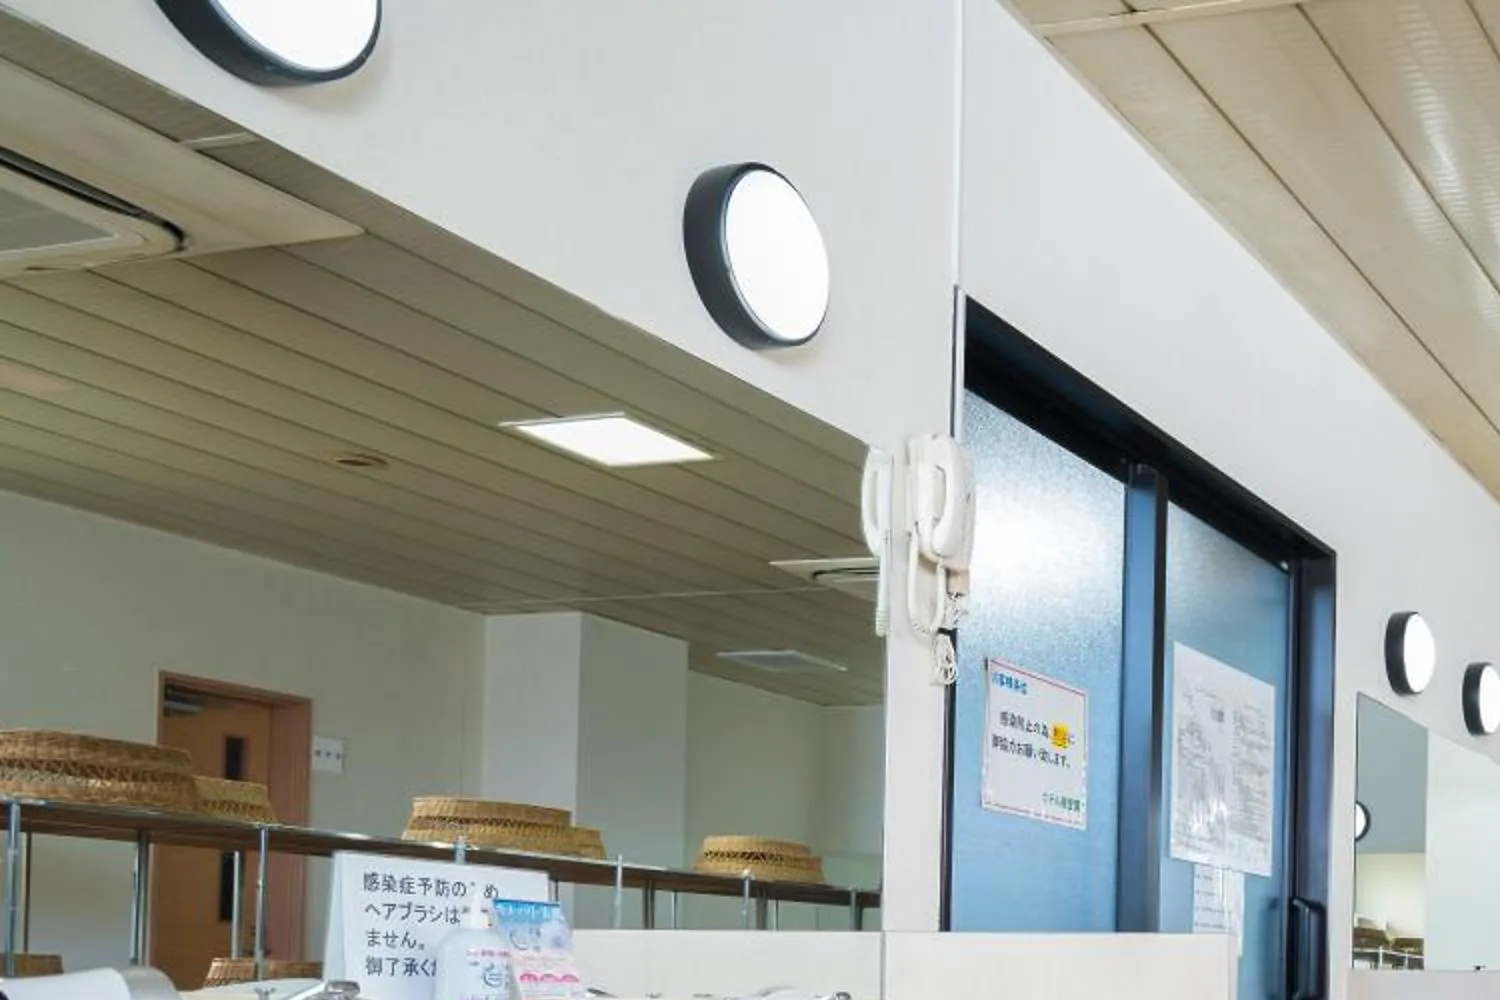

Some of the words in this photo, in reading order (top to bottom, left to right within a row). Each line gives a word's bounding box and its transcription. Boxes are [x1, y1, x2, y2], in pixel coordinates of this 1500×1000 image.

[363, 872, 498, 899] 感染症予防のめ
[364, 901, 471, 925] ヘアブラシは
[366, 928, 425, 951] ません。
